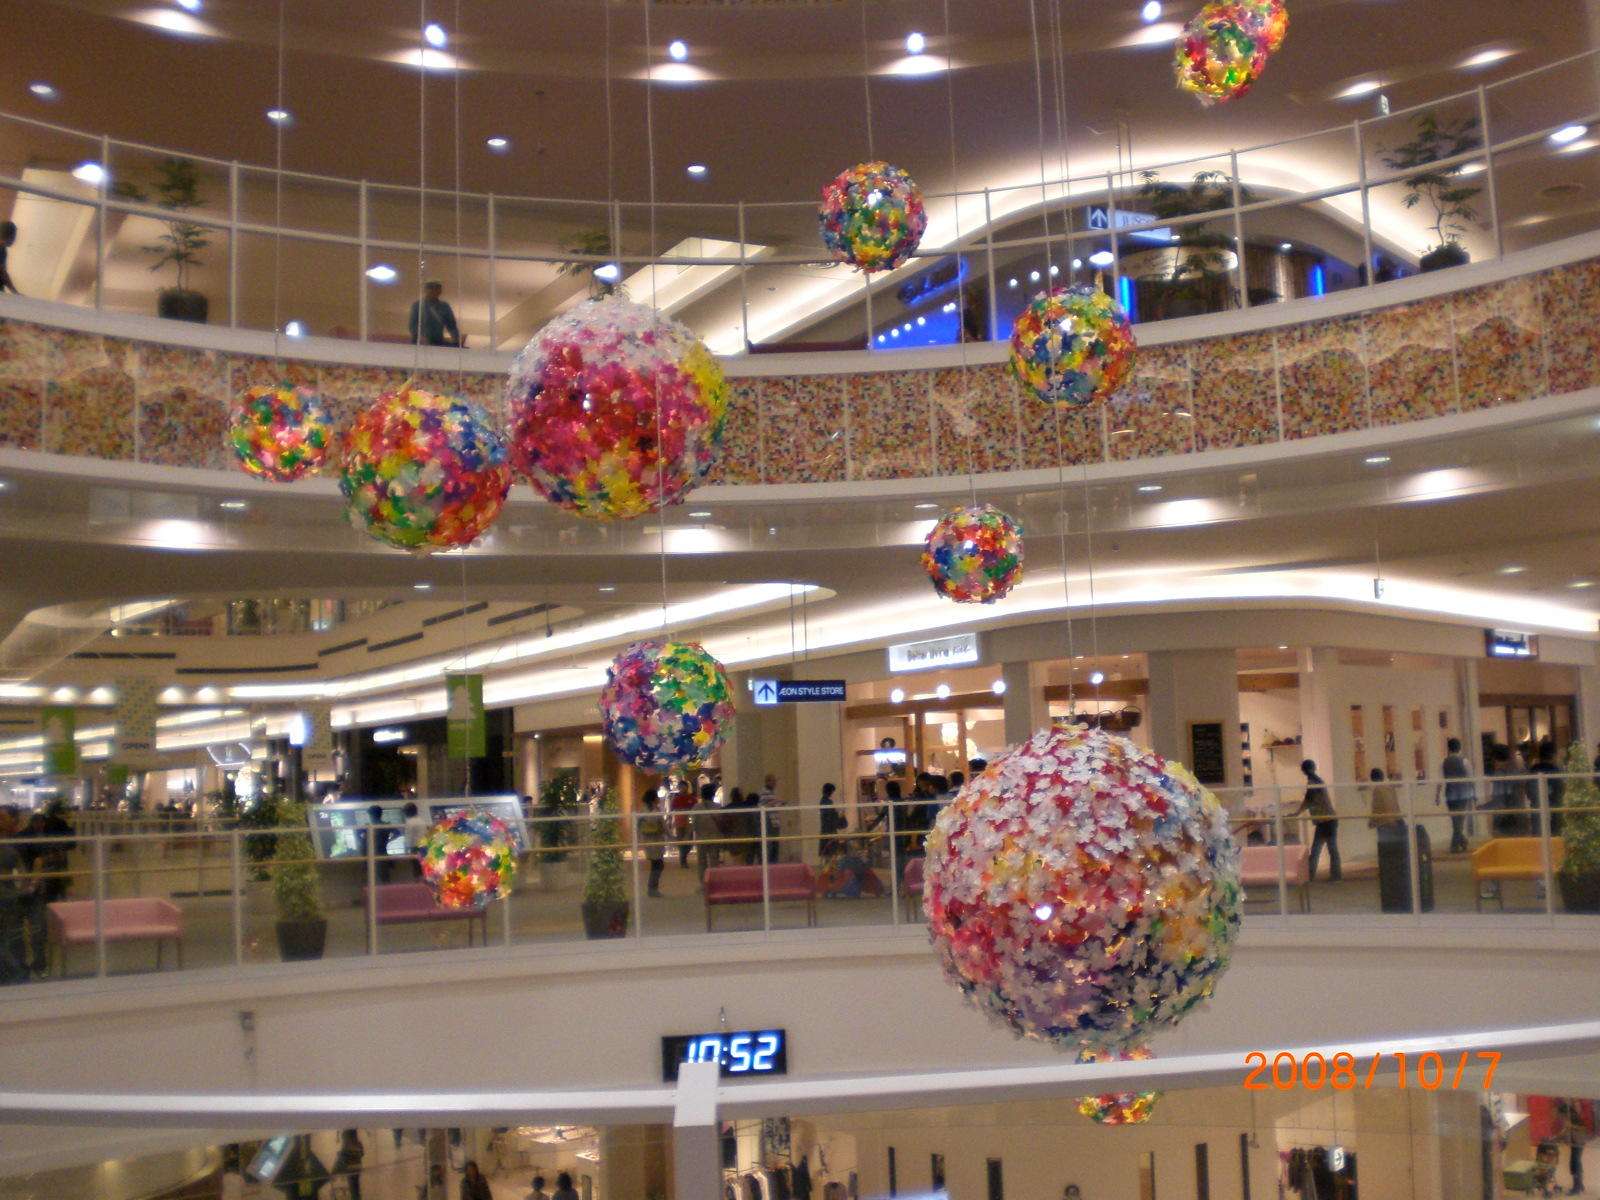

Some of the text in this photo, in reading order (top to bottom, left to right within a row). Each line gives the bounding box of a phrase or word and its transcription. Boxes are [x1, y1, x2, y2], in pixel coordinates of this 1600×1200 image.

[799, 687, 820, 696] STYLE
[821, 686, 844, 695] STORE
[687, 1037, 778, 1072] 10:52
